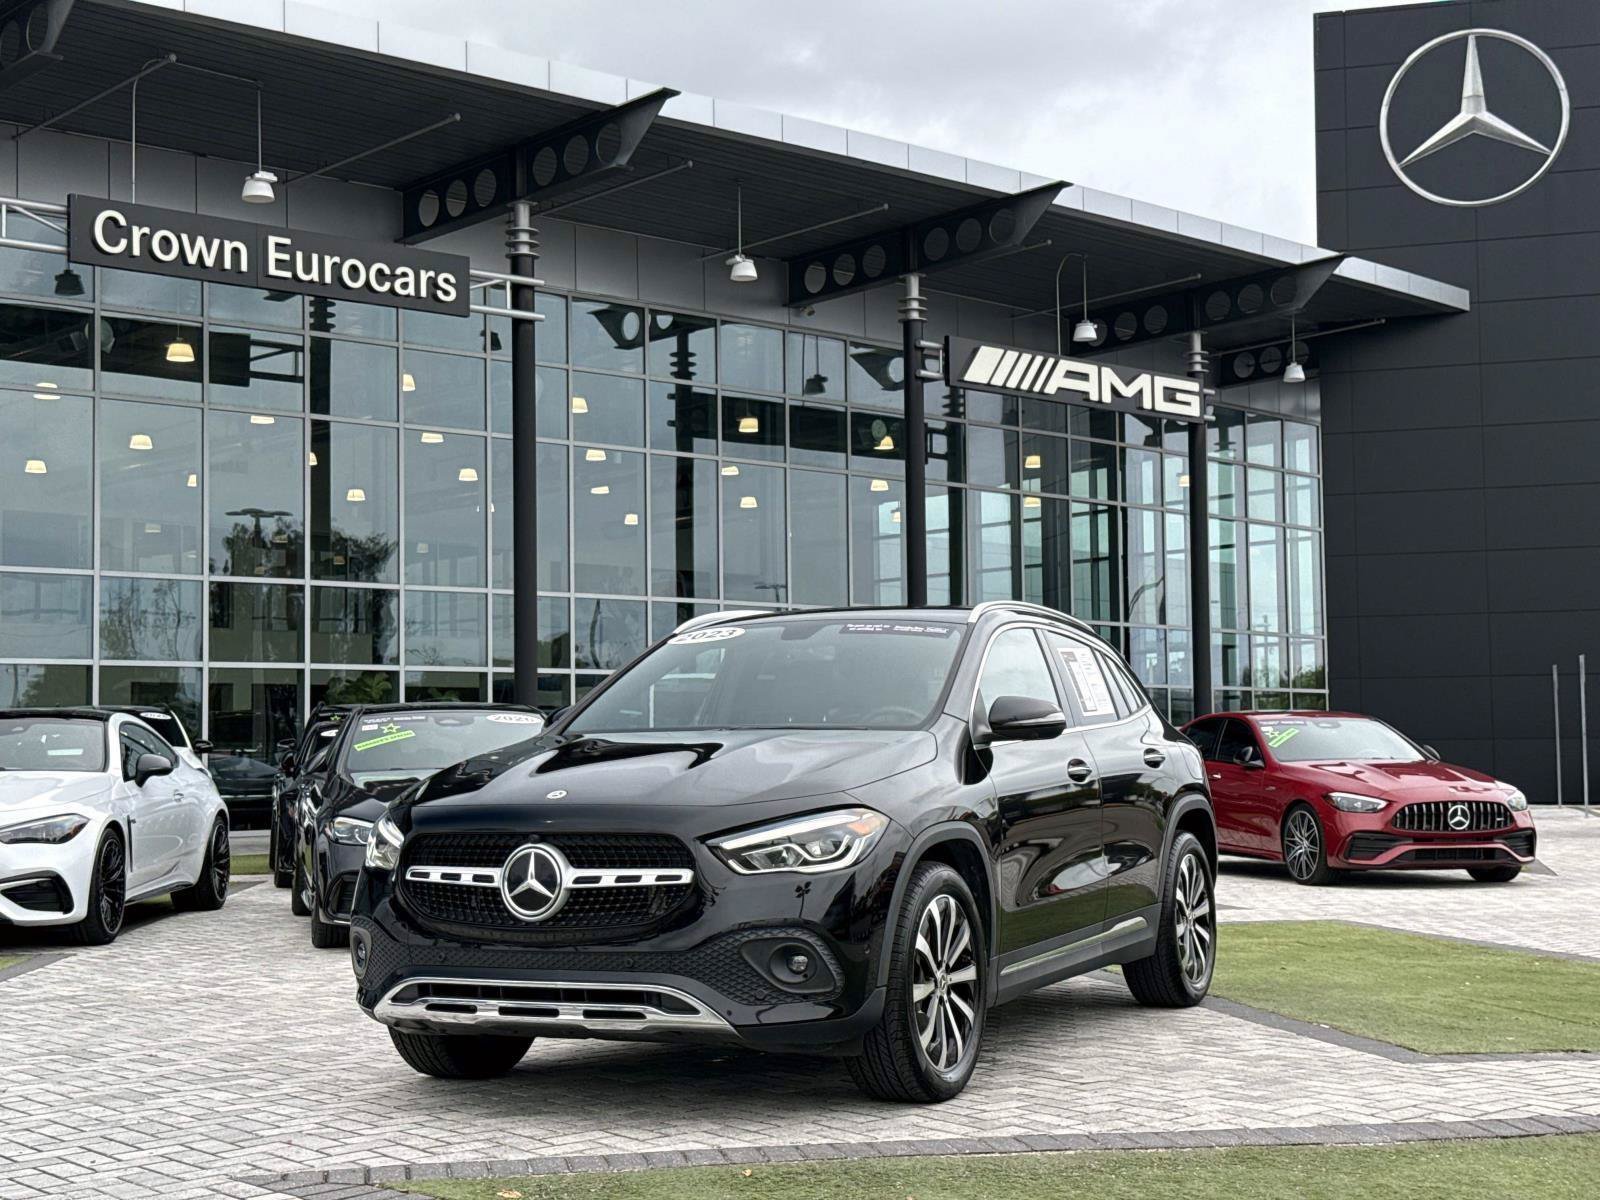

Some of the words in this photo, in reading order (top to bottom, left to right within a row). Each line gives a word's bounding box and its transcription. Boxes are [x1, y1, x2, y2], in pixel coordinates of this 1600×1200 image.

[92, 209, 248, 273] Crown
[266, 234, 457, 303] Eurocars
[1044, 358, 1202, 418] AMG
[675, 629, 738, 642] 2023
